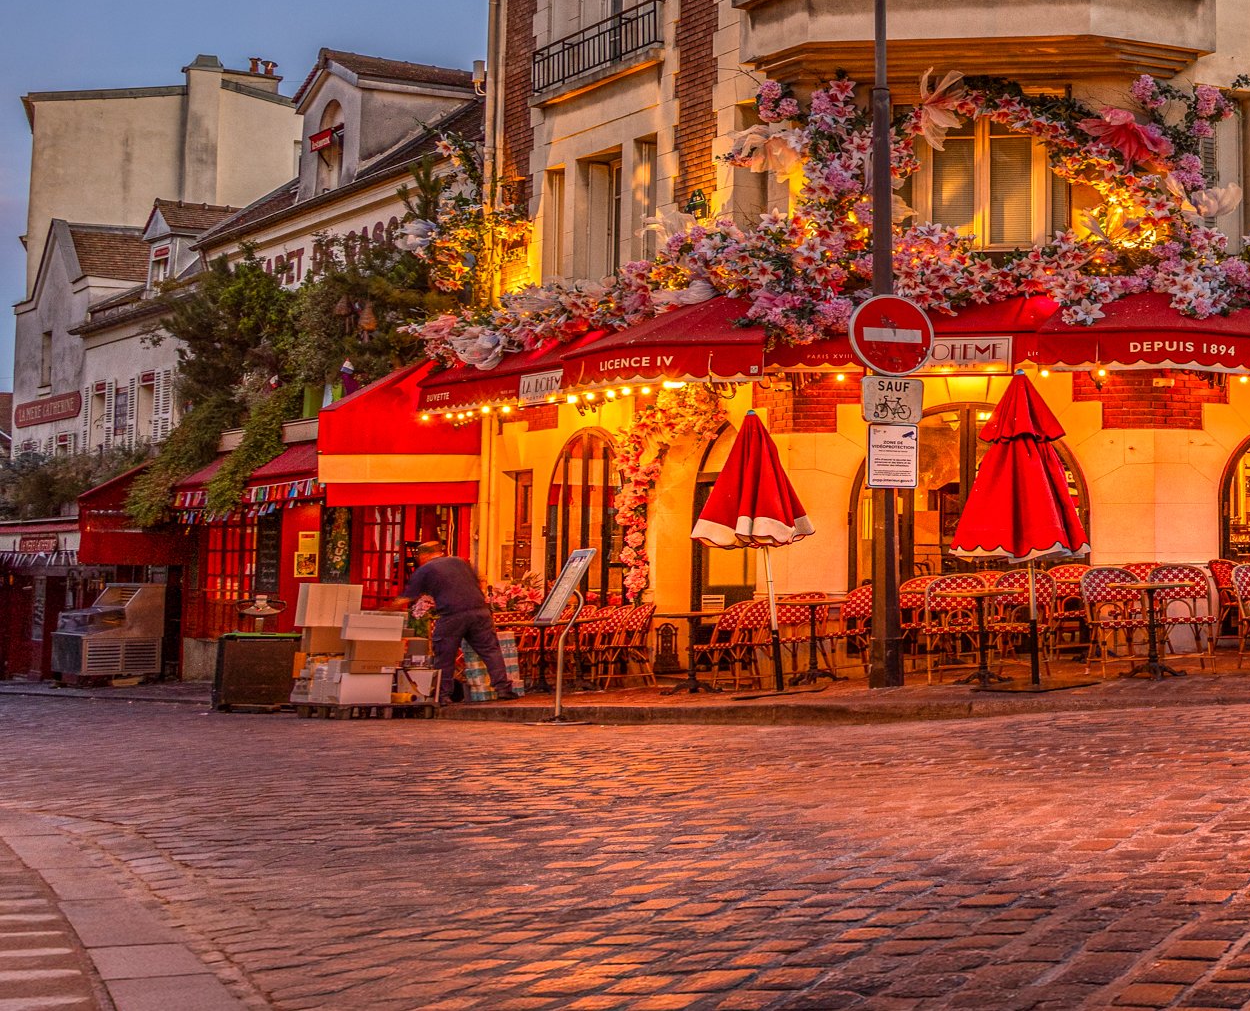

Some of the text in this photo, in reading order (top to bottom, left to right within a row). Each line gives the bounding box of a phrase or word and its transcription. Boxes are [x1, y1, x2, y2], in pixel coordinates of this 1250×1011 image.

[930, 343, 1003, 361] OHEME
[1129, 341, 1236, 357] DEPUIS 1894
[599, 355, 674, 372] LICENCE IV
[522, 376, 561, 395] LA BOHEM
[878, 380, 911, 392] SAUF
[426, 391, 450, 403] BUVETTE
